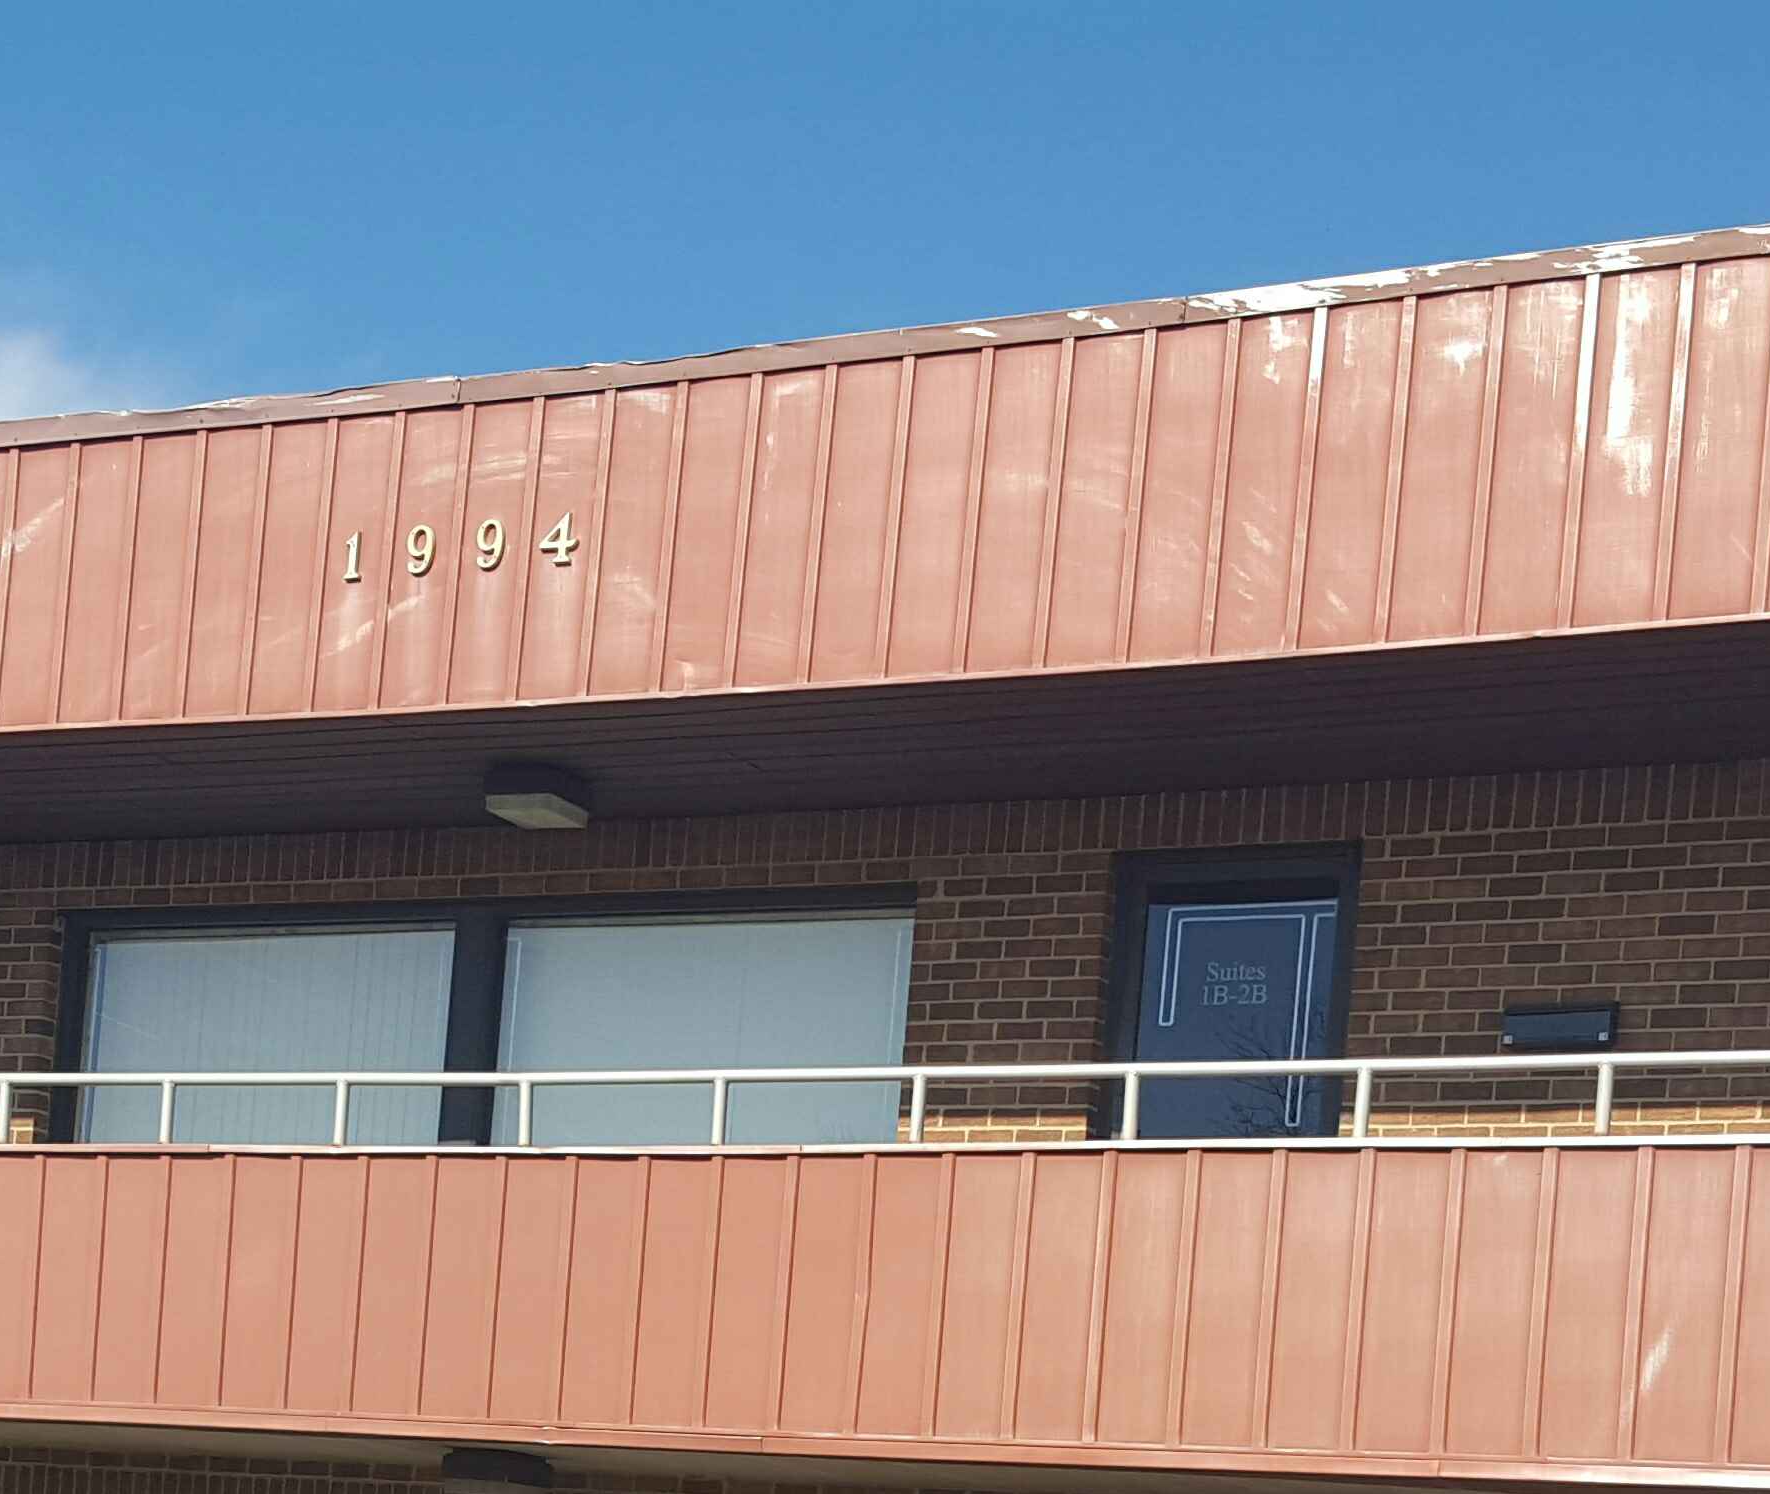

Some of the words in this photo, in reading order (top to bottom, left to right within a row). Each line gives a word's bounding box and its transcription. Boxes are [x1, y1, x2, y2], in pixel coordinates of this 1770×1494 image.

[342, 511, 579, 583] 1994
[1206, 961, 1266, 981] Suites
[1201, 983, 1268, 1005] 1B-2B
